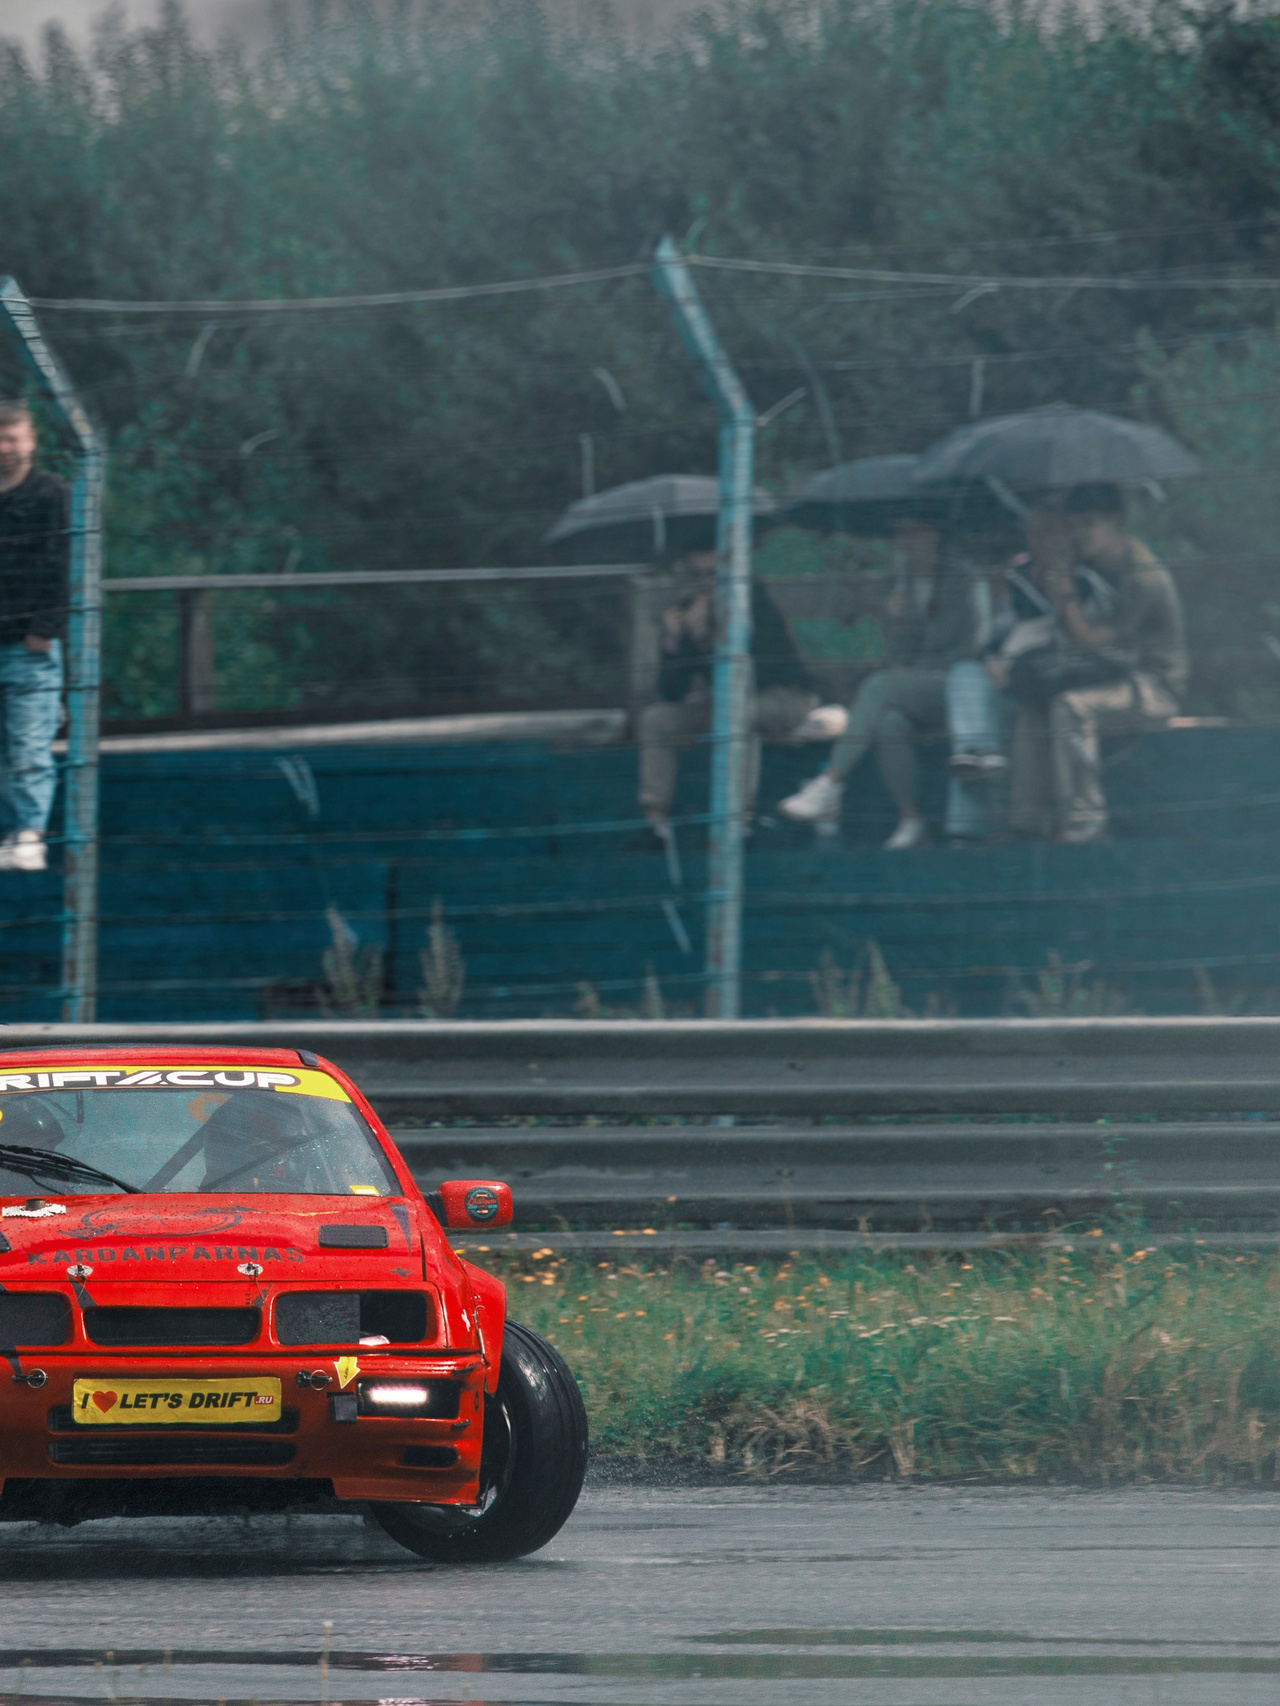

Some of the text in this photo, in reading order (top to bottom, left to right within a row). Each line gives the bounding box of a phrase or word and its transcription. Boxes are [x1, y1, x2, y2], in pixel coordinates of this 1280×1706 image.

[166, 1071, 296, 1087] CUP
[28, 1246, 304, 1265] KARDANPARNAS
[81, 1394, 90, 1409] I
[120, 1394, 182, 1409] LET'S
